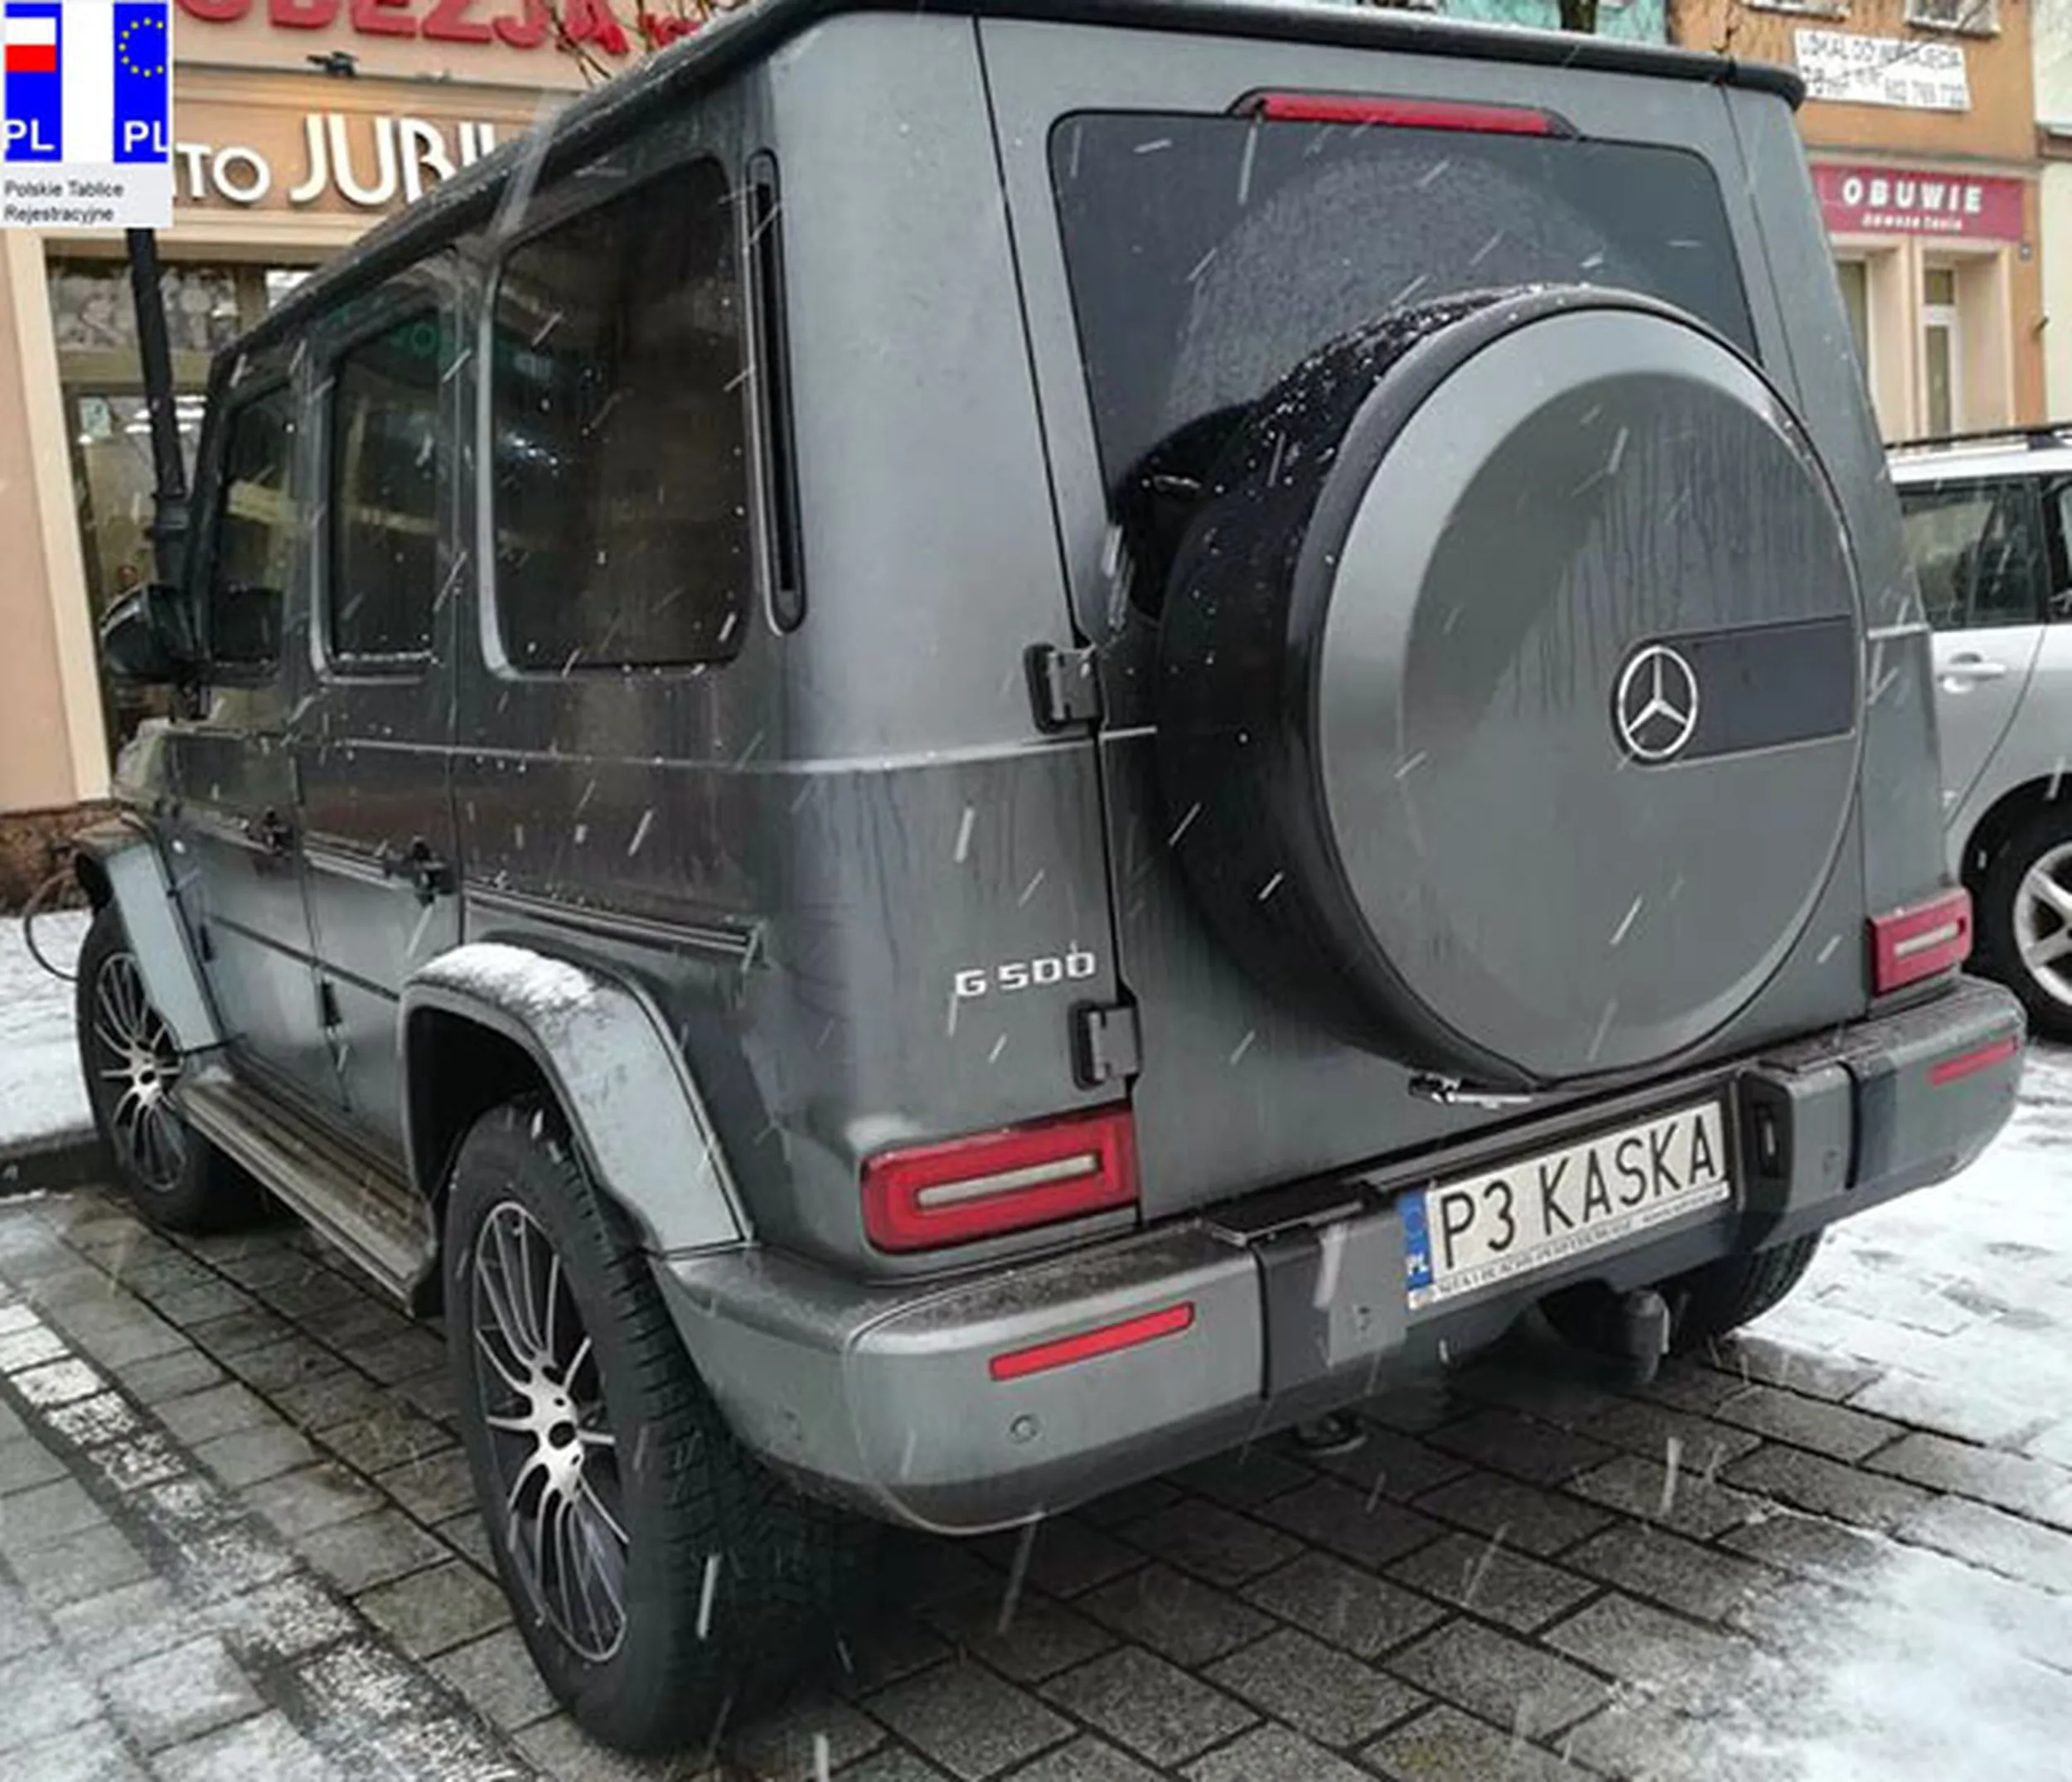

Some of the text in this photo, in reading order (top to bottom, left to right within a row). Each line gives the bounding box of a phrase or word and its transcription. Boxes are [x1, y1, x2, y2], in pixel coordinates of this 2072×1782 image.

[171, 143, 271, 201] TO
[1842, 177, 1982, 214] OBUWIE
[955, 951, 1096, 997] G 500
[1440, 1179, 1516, 1270] P3
[1538, 1114, 1716, 1236] KASKA
